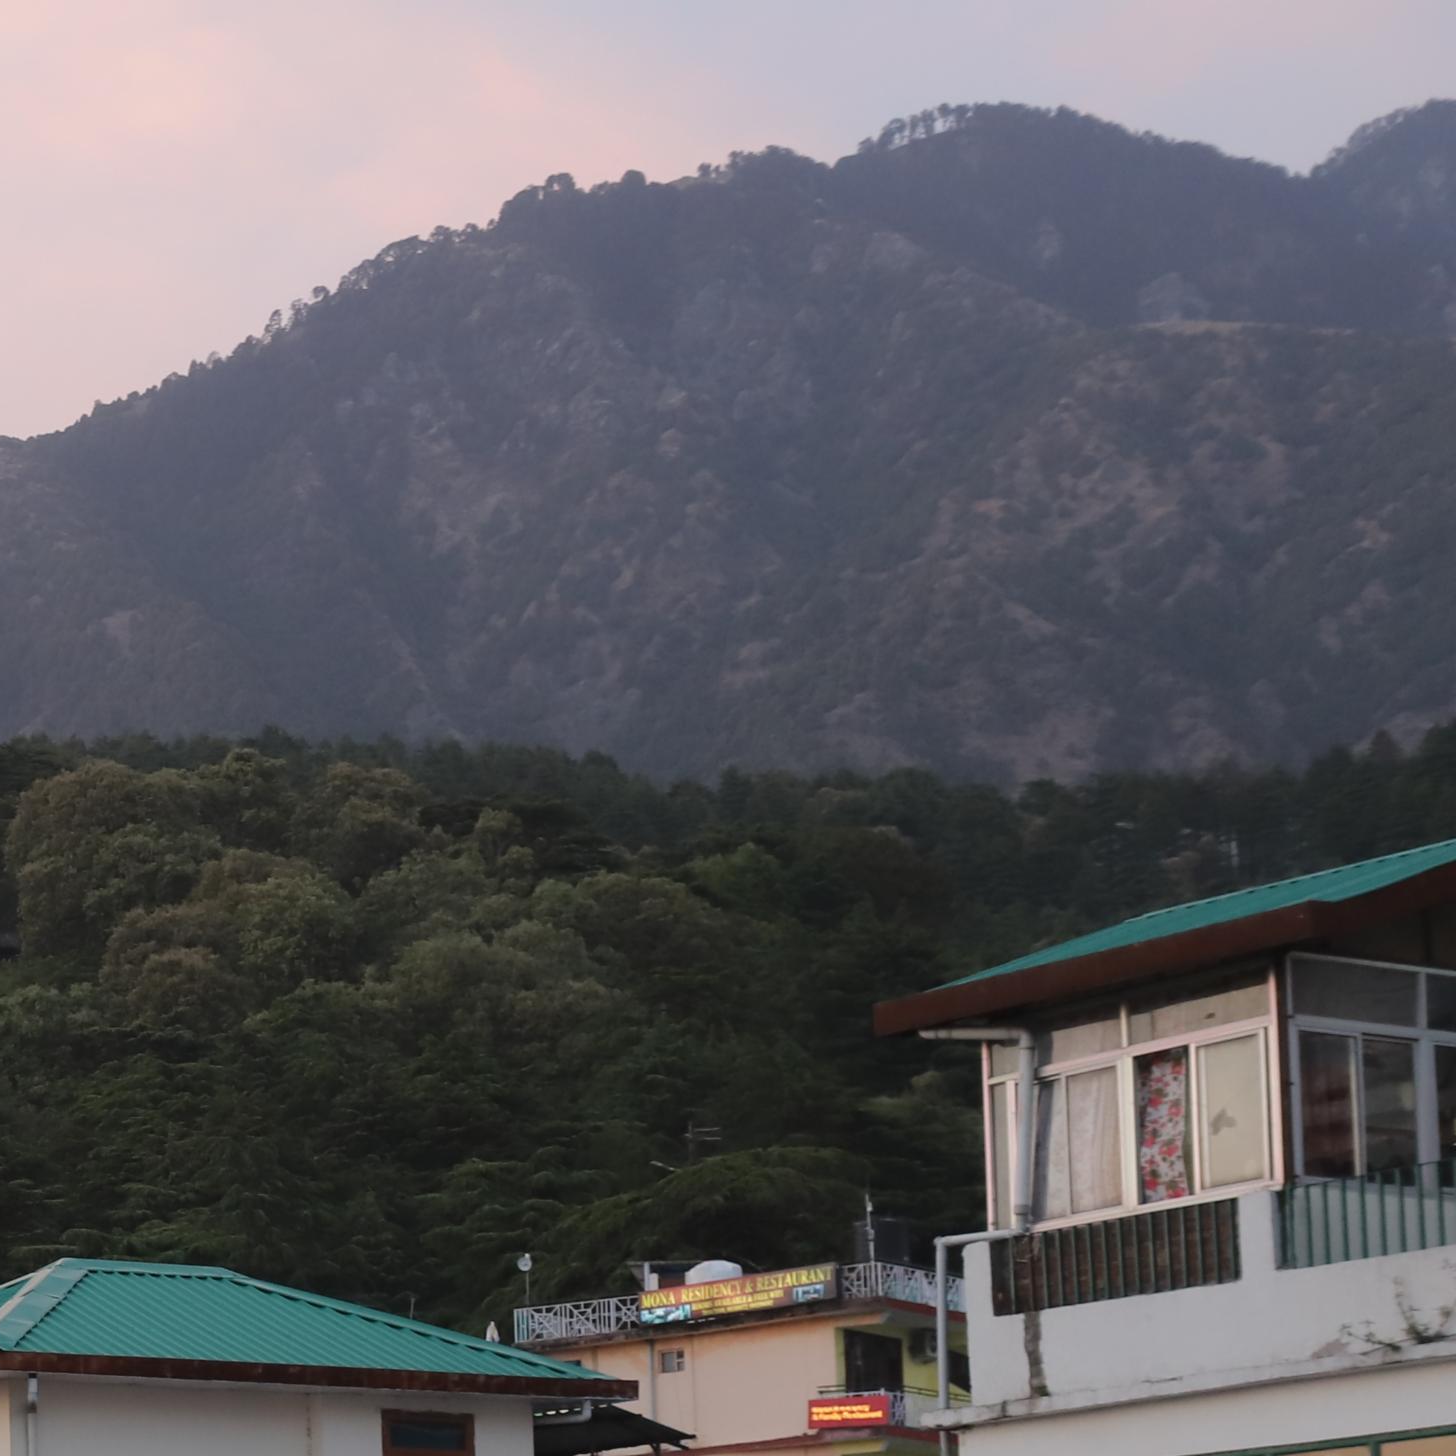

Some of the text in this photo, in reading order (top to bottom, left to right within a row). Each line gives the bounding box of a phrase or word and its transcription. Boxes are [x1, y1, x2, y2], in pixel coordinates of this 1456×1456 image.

[641, 1292, 675, 1308] MONA
[681, 1280, 743, 1303] RESIDENCY
[756, 1266, 834, 1290] RESTAURANT
